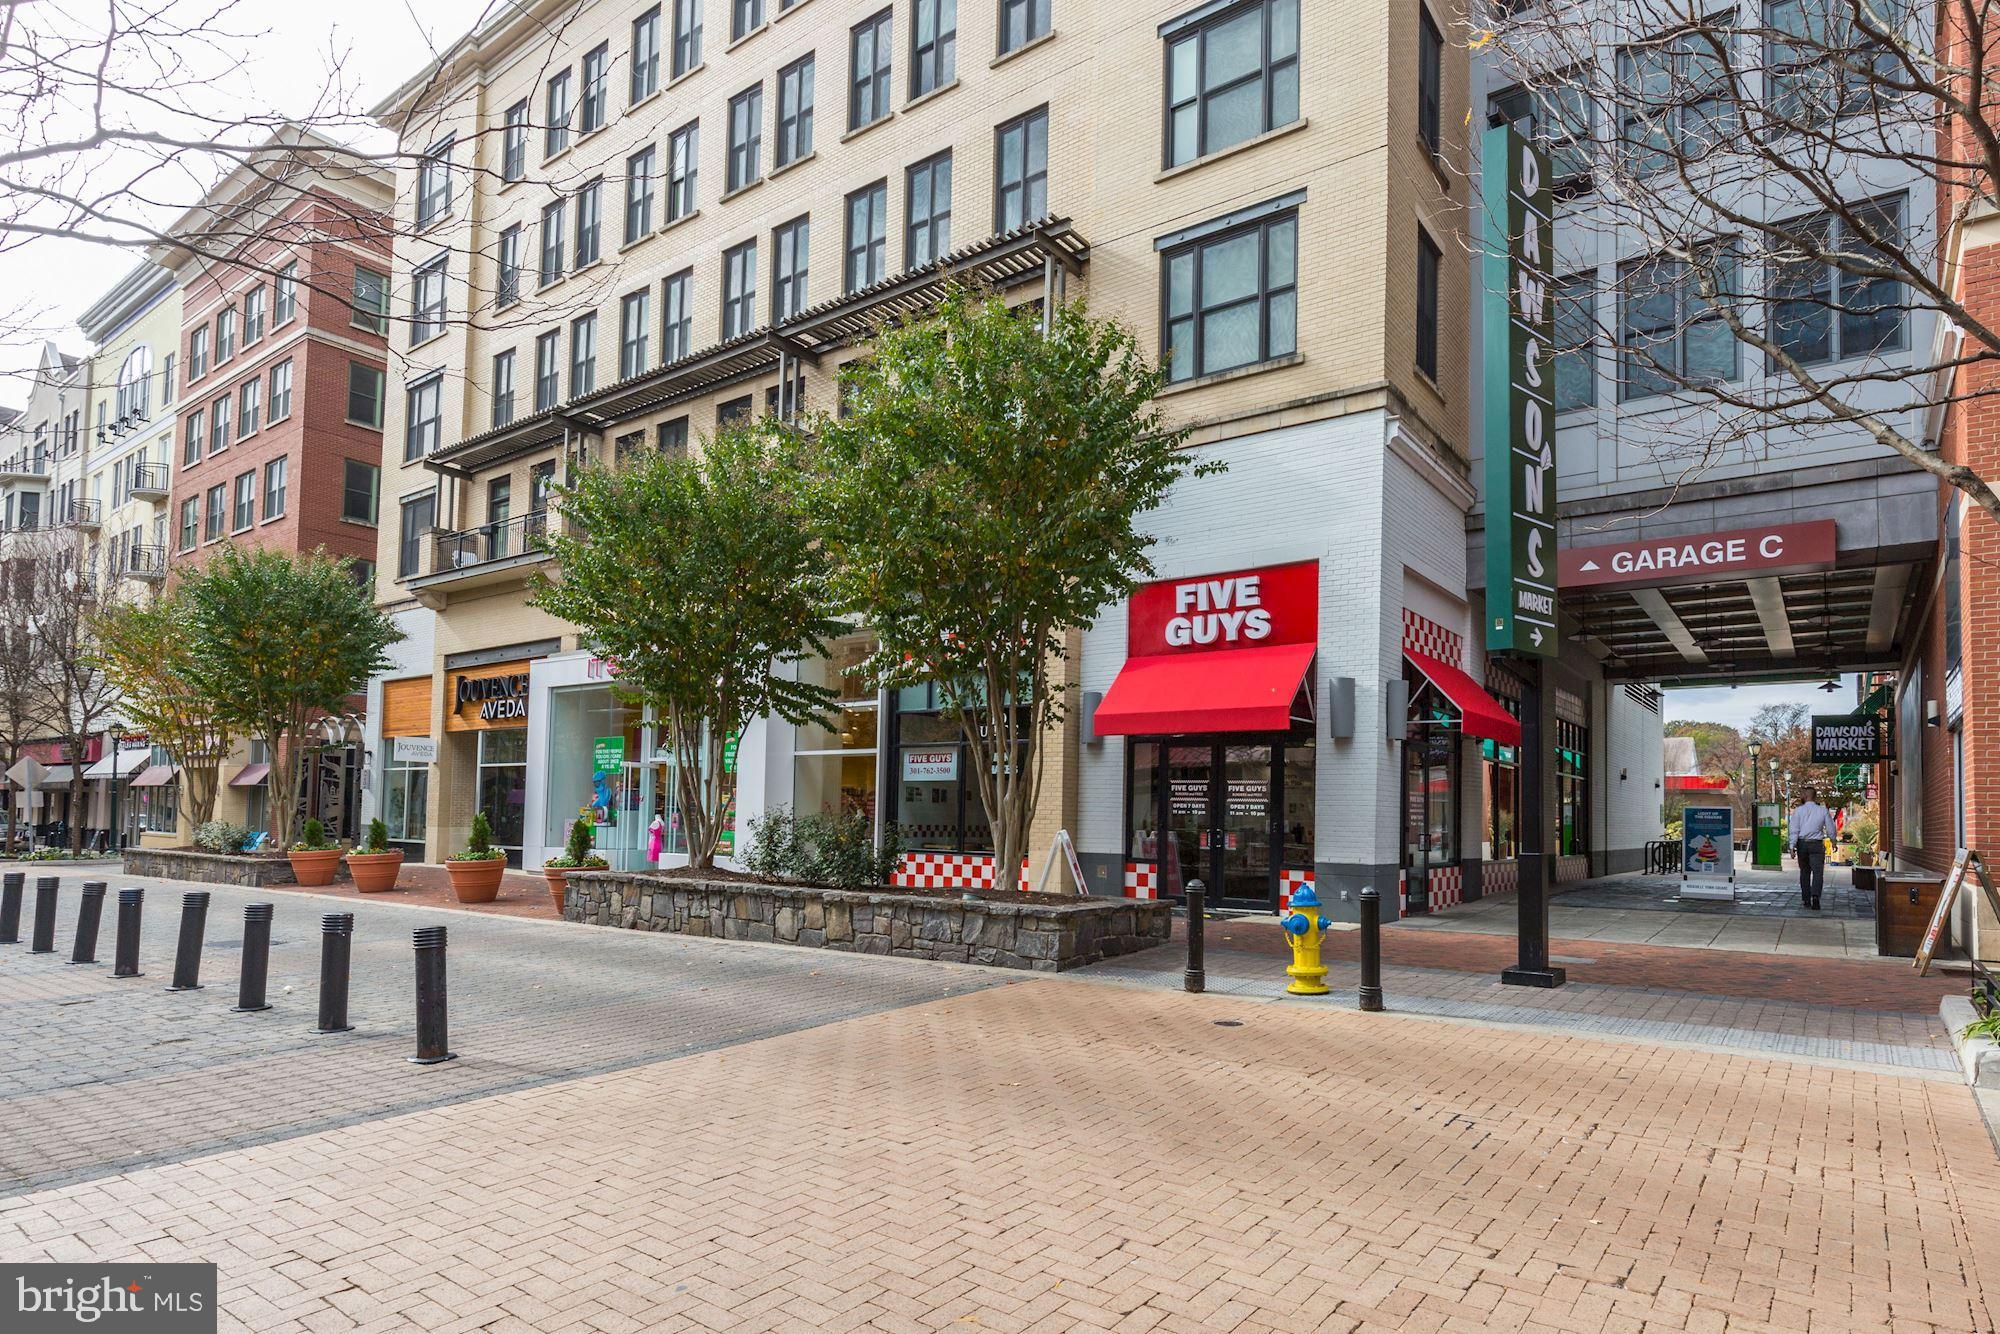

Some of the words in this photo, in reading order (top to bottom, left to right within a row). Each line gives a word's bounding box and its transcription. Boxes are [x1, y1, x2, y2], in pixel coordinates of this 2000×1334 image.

[1611, 538, 1747, 573] GARAGE
[1759, 535, 1784, 558] C
[1175, 575, 1261, 614] FIVE
[1518, 590, 1554, 616] MARKET
[1165, 608, 1272, 647] GUYS
[453, 674, 529, 714] JOUVENCE
[479, 698, 527, 719] AVEDA
[397, 742, 435, 752] JOUVENCE
[1815, 737, 1876, 751] MARKET
[909, 754, 928, 763] FIVE
[929, 754, 952, 763] GUYS
[909, 767, 951, 775] 301-762-3500
